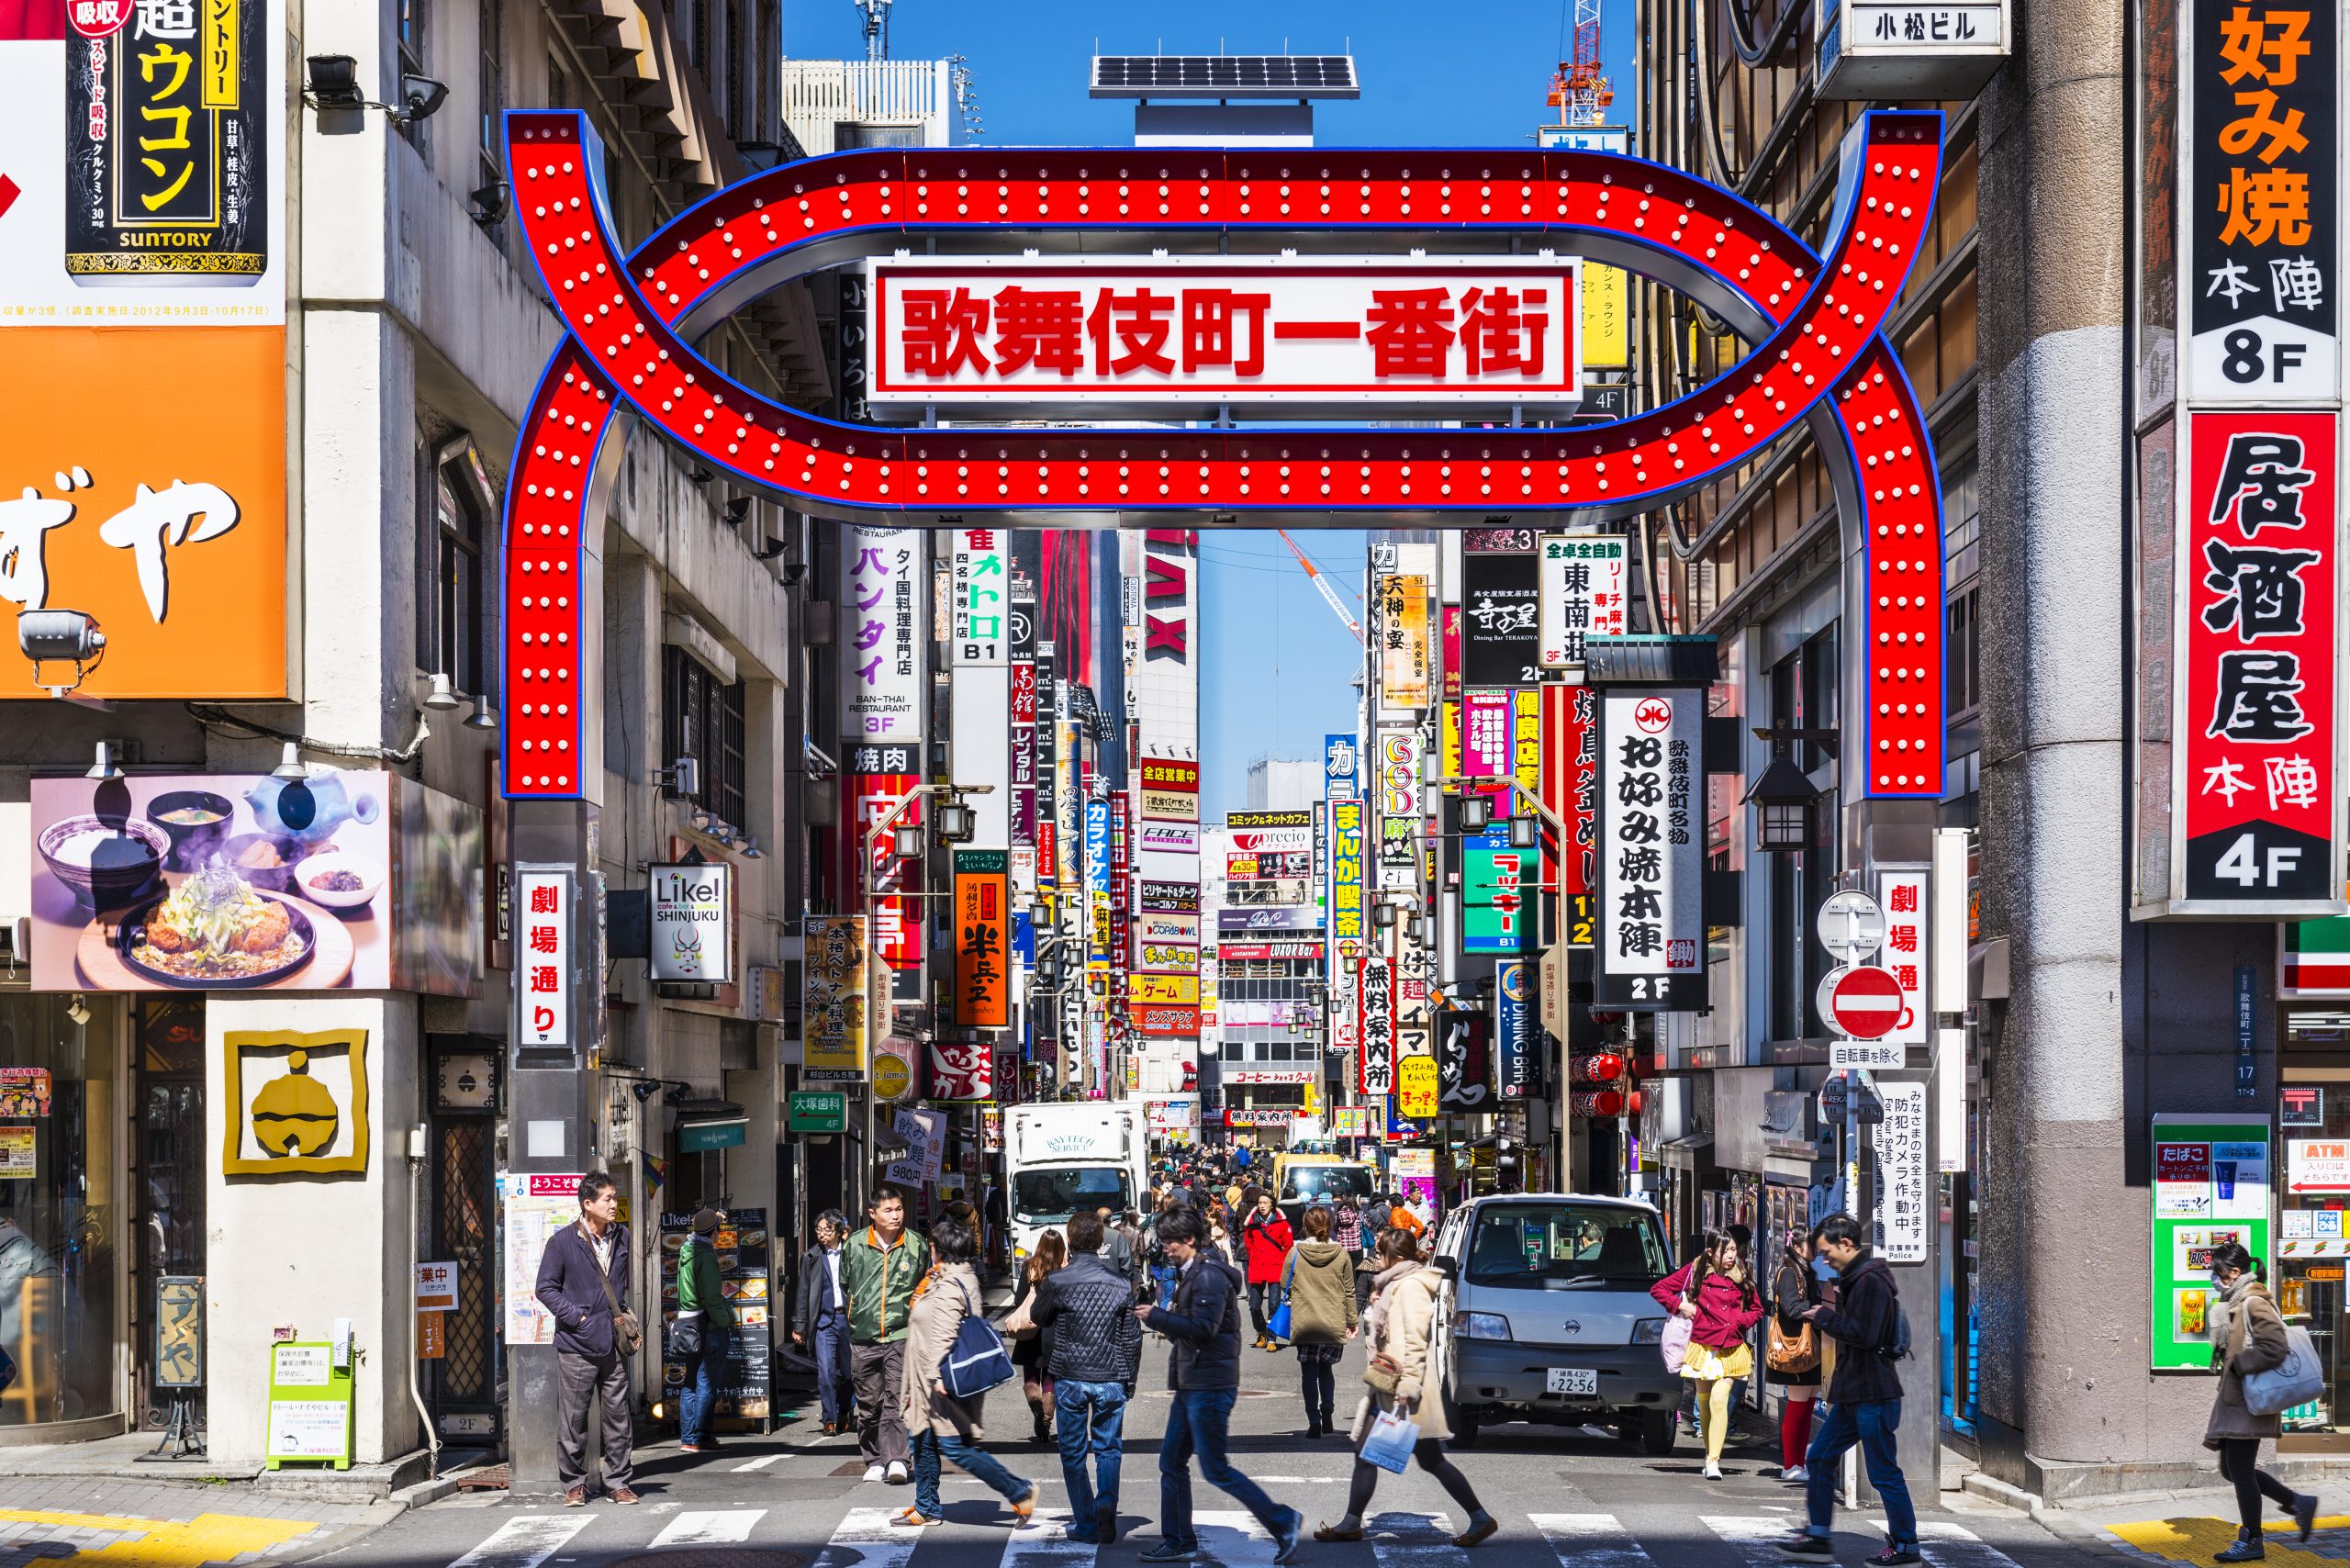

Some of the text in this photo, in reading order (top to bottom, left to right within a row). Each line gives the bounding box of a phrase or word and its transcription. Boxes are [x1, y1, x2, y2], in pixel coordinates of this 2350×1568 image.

[1875, 12, 1975, 40] 小松ビル
[91, 41, 106, 140] スピード吸収
[2216, 6, 2312, 248] 好み焼
[93, 143, 105, 206] クルクミン
[227, 119, 240, 225] 甘草・桂皮・生姜
[119, 230, 213, 248] SUNTORY
[2206, 254, 2323, 313] 本陣
[901, 286, 1550, 377] 歌舞伎町一番街
[2221, 328, 2307, 384] 8F
[1595, 392, 1617, 409] 4F
[1547, 543, 1622, 559] 全卓全自動
[1414, 577, 1426, 586] 5F
[2203, 431, 2322, 745] 居酒屋
[956, 553, 968, 639] 四名様専門店
[969, 554, 1002, 640] メトロ
[850, 547, 890, 686] バンタイ
[896, 549, 912, 676] タイ国料理専門店
[1386, 576, 1404, 650] 天神の宴
[1563, 562, 1591, 662] 東南荘
[1595, 593, 1608, 631] 専門
[1414, 640, 1423, 678] 完全個室
[1546, 650, 1561, 662] 3F
[849, 705, 912, 713] RESTAURANT
[856, 695, 906, 704] BAN-THAI
[865, 717, 895, 733] 3F
[855, 748, 907, 773] 焼肉
[1016, 728, 1031, 782] レンタル
[1143, 766, 1196, 784] 全店営業中
[1386, 736, 1415, 815] GOD
[2202, 753, 2319, 812] 本陣
[1667, 739, 1690, 846] 歌舞伎町名物
[1144, 827, 1197, 839] FACE
[1228, 814, 1310, 825] コミック&ネットカフェ
[1617, 734, 1663, 958] お好み焼本陣
[2214, 832, 2302, 888] 4F
[1336, 803, 1362, 937] まんが喫茶
[657, 873, 719, 903] Like!
[1142, 884, 1198, 899] ビリヤード&ダーツ
[1493, 854, 1521, 933] ラッキー
[657, 911, 719, 923] SHINJUKU
[1159, 900, 1178, 910] ゴルフ
[1178, 902, 1198, 910] バグース
[808, 920, 827, 933] 5F
[1096, 908, 1108, 943] 麻雀
[1144, 946, 1196, 964] まんが喫茶
[1270, 944, 1296, 958] LUXOR
[1297, 945, 1315, 957] Bar
[1498, 937, 1516, 946] B1
[531, 885, 559, 1032] 劇場通り
[828, 927, 845, 1033] 本格ベトナム料理
[1144, 983, 1178, 999] ゲーム
[1546, 963, 1555, 1020] 劇場通り一番街
[1631, 976, 1671, 999] 2F
[878, 973, 887, 1029] 劇場通り一番街
[1145, 1010, 1194, 1022] メンズサウナ
[1364, 964, 1393, 1089] 無料案内所
[2240, 992, 2251, 1057] 歌舞伎町一丁目
[1513, 1002, 1530, 1084] DINING BAR
[1836, 1048, 1900, 1064] 自転車を除く
[881, 1071, 908, 1080] James
[1236, 1072, 1271, 1082] コーヒー
[2237, 1066, 2254, 1079] 17
[794, 1097, 840, 1111] 大塚歯科
[1507, 1086, 1516, 1094] B1
[2237, 1088, 2255, 1096] 17-2
[826, 1119, 839, 1128] 4F
[1231, 1111, 1292, 1122] 無料案内所
[1885, 1098, 1894, 1165] For Your Safety
[1894, 1098, 1909, 1232] 防犯カメラ作動中
[1910, 1091, 1922, 1238] みなさまの安全を守ります
[2163, 1148, 2203, 1161] たばこ
[2306, 1144, 2345, 1158] ATM
[1876, 1150, 1885, 1185] Camera
[2302, 1172, 2348, 1182] そちらです
[2307, 1162, 2344, 1170] 入り口は
[1876, 1198, 1886, 1239] Operation
[1888, 1251, 1913, 1260] Police
[1558, 1379, 1595, 1392] 22-56
[459, 1418, 476, 1430] 2F
